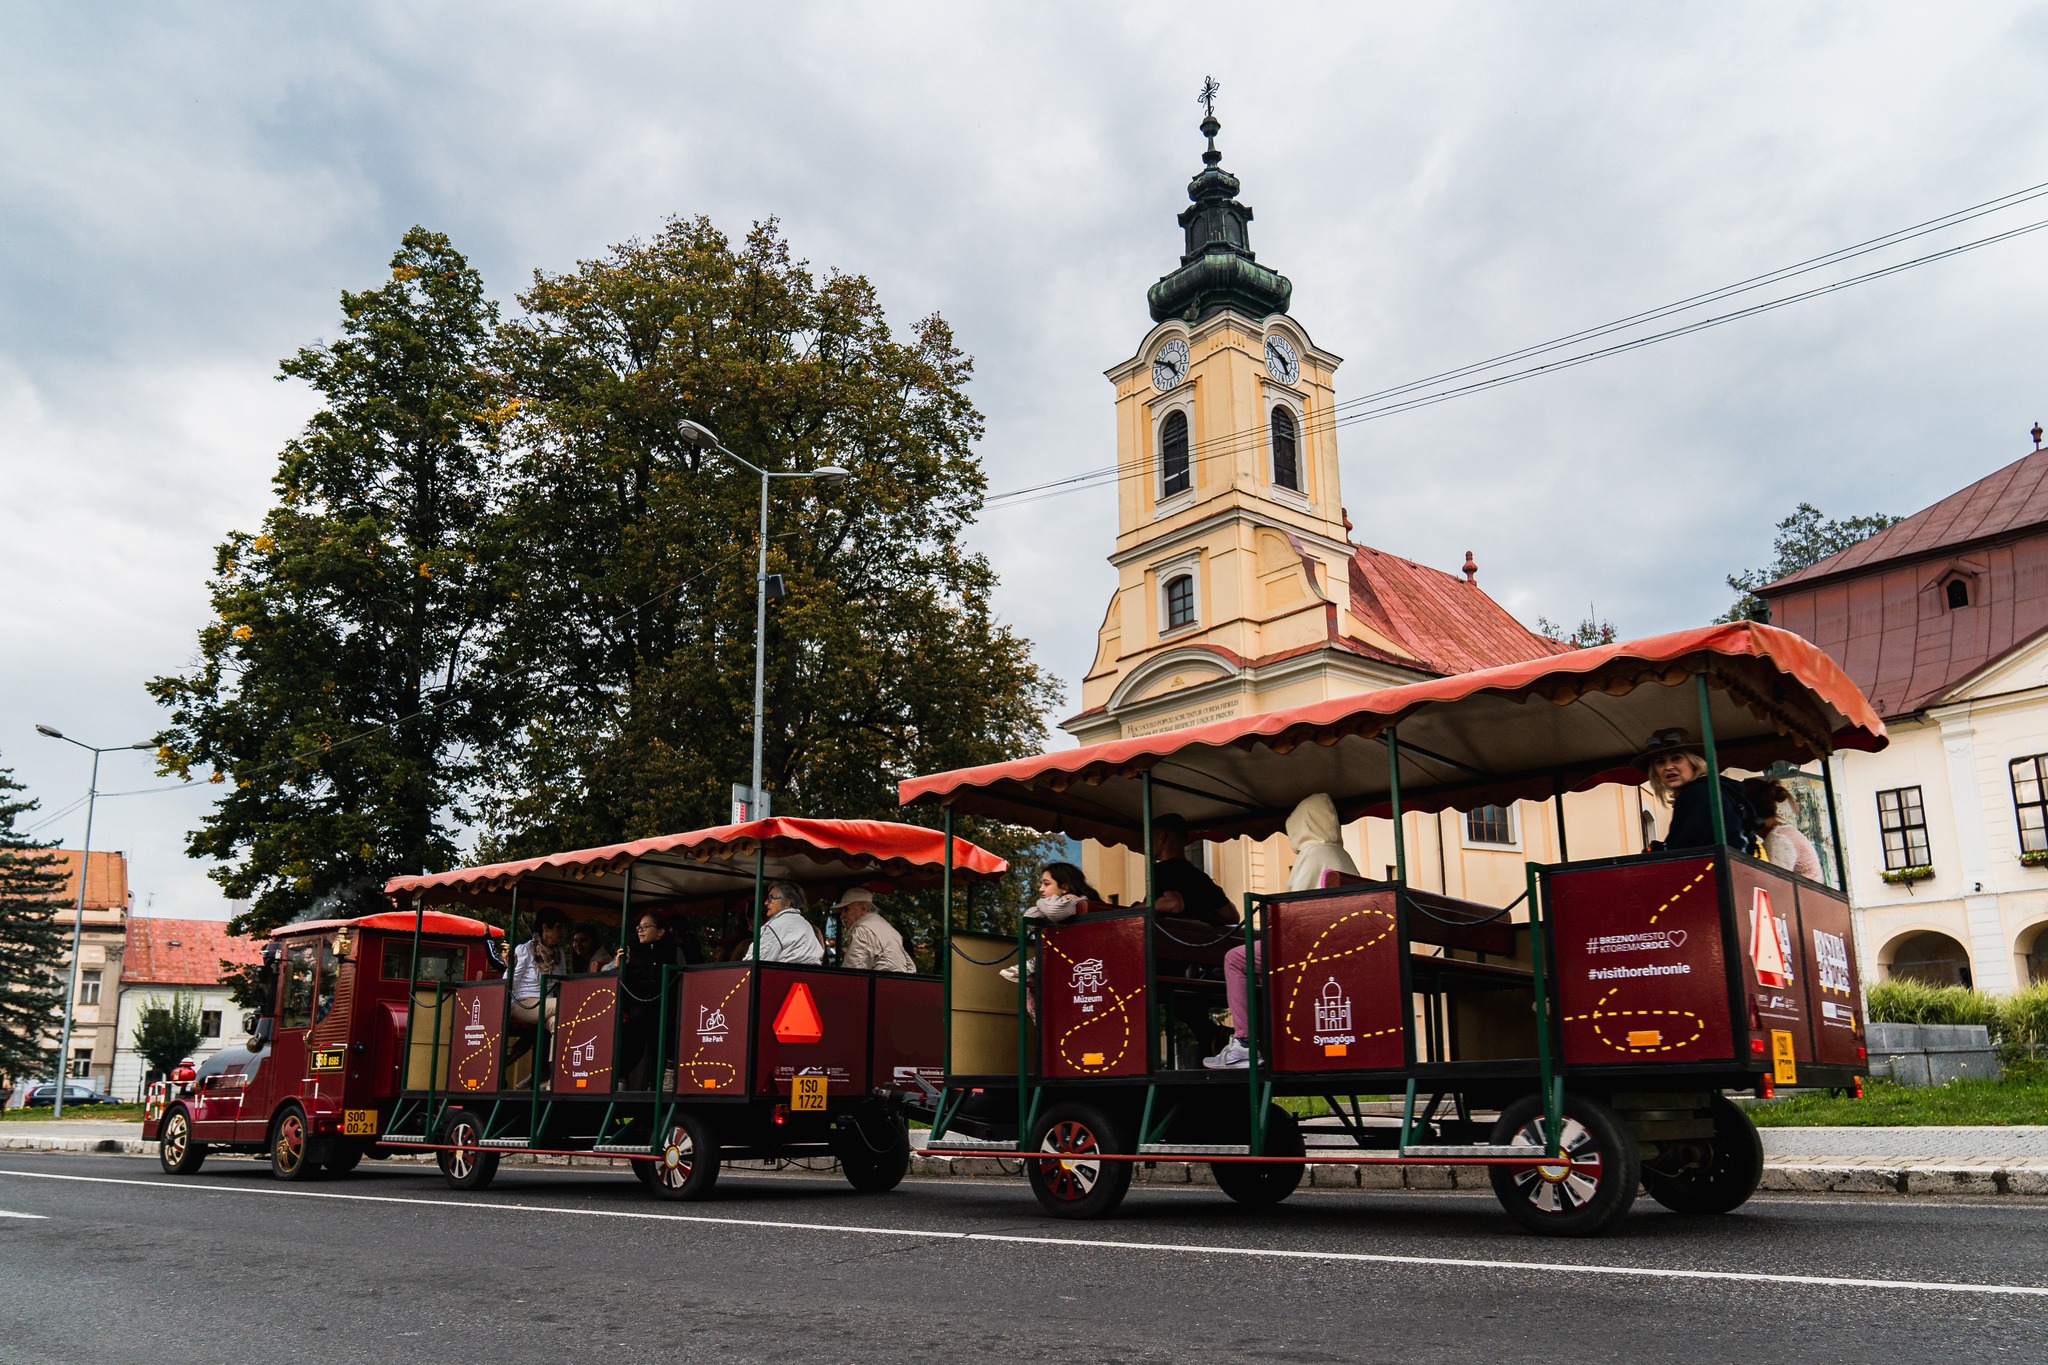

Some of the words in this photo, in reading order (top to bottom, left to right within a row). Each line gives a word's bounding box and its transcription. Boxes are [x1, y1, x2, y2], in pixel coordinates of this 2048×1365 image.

[1588, 962, 1691, 980] #visithorehronie
[1073, 994, 1102, 1004] Múzeum
[1082, 1004, 1094, 1012] áut
[1313, 1034, 1356, 1046] Synagóga
[798, 1094, 824, 1108] 1722
[346, 1123, 374, 1134] 00-21
